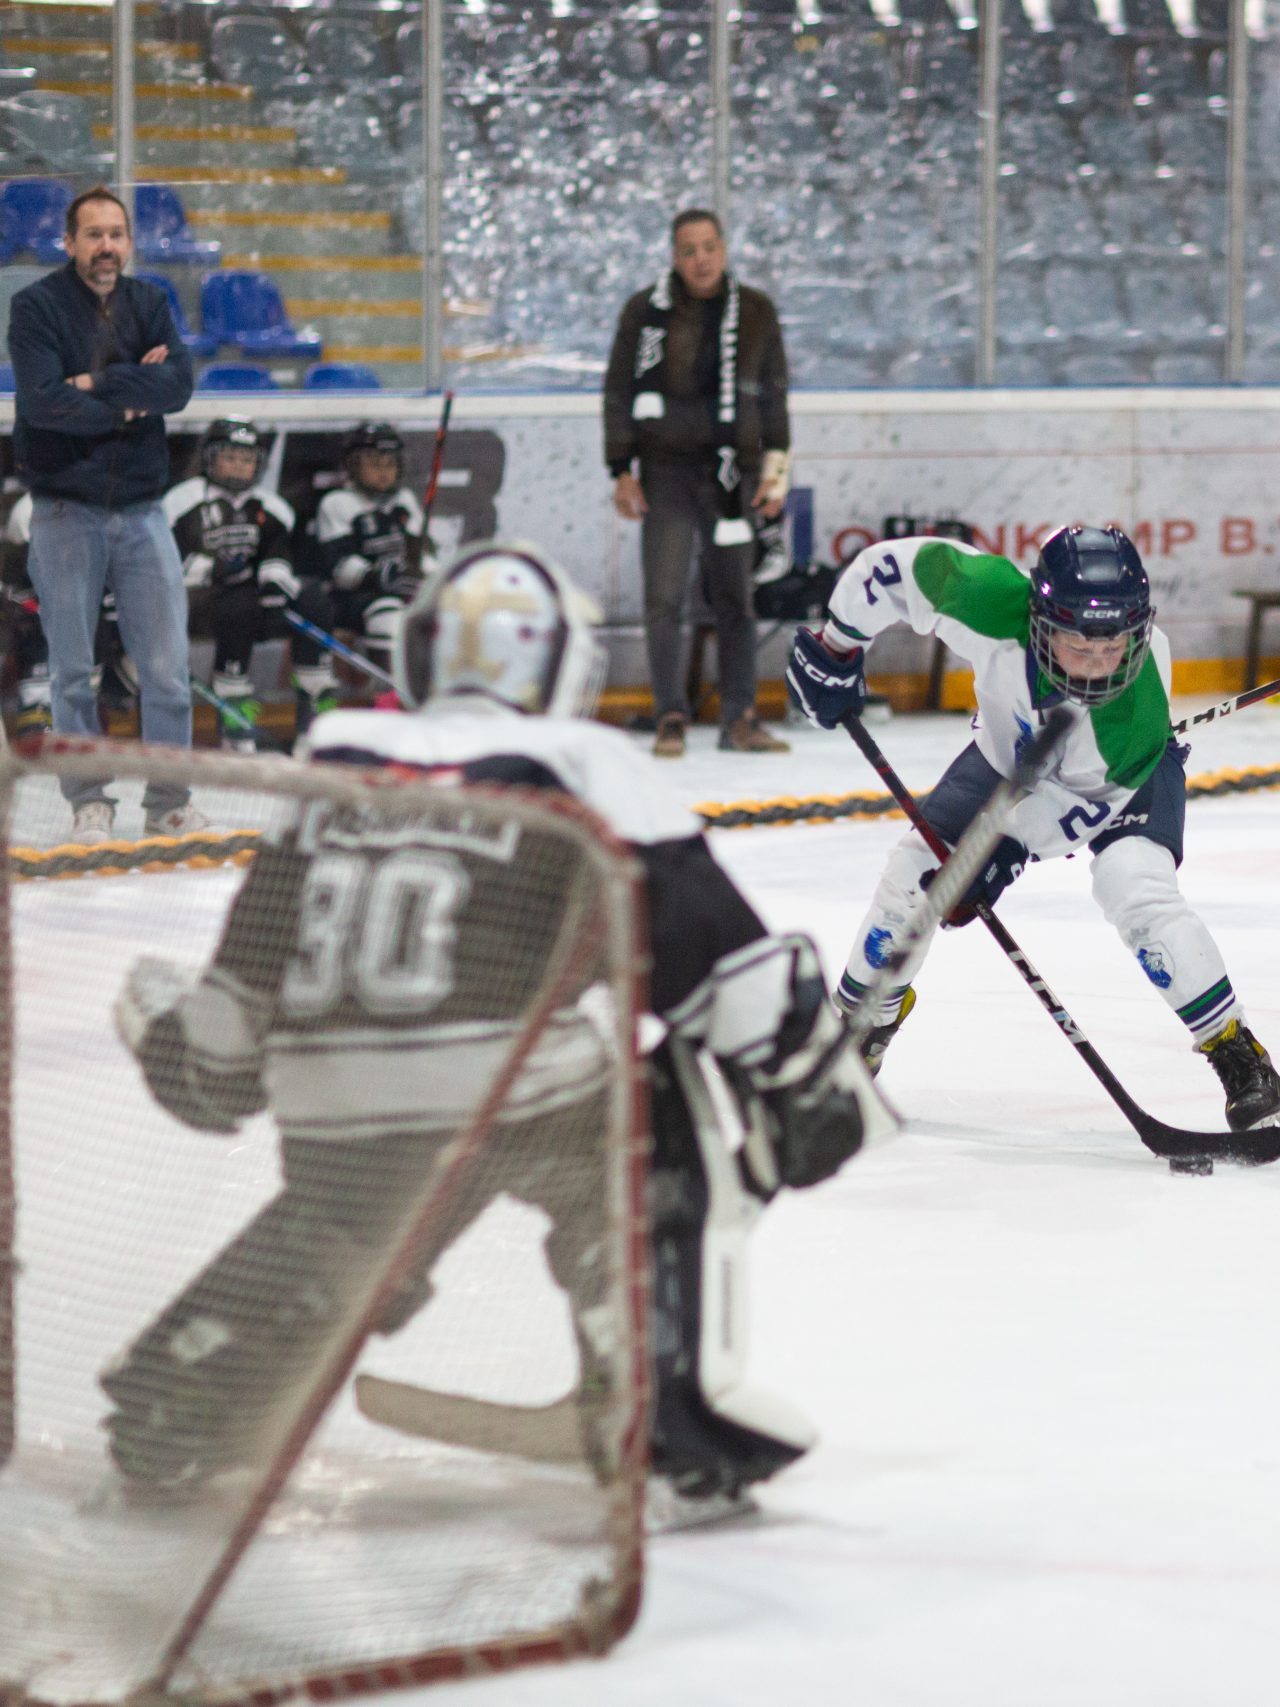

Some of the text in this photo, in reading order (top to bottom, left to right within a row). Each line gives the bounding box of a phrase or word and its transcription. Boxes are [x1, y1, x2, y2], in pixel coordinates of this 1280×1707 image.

[863, 552, 903, 606] 2
[1082, 608, 1122, 619] CCM
[794, 646, 858, 688] CCM
[1058, 798, 1111, 842] 2
